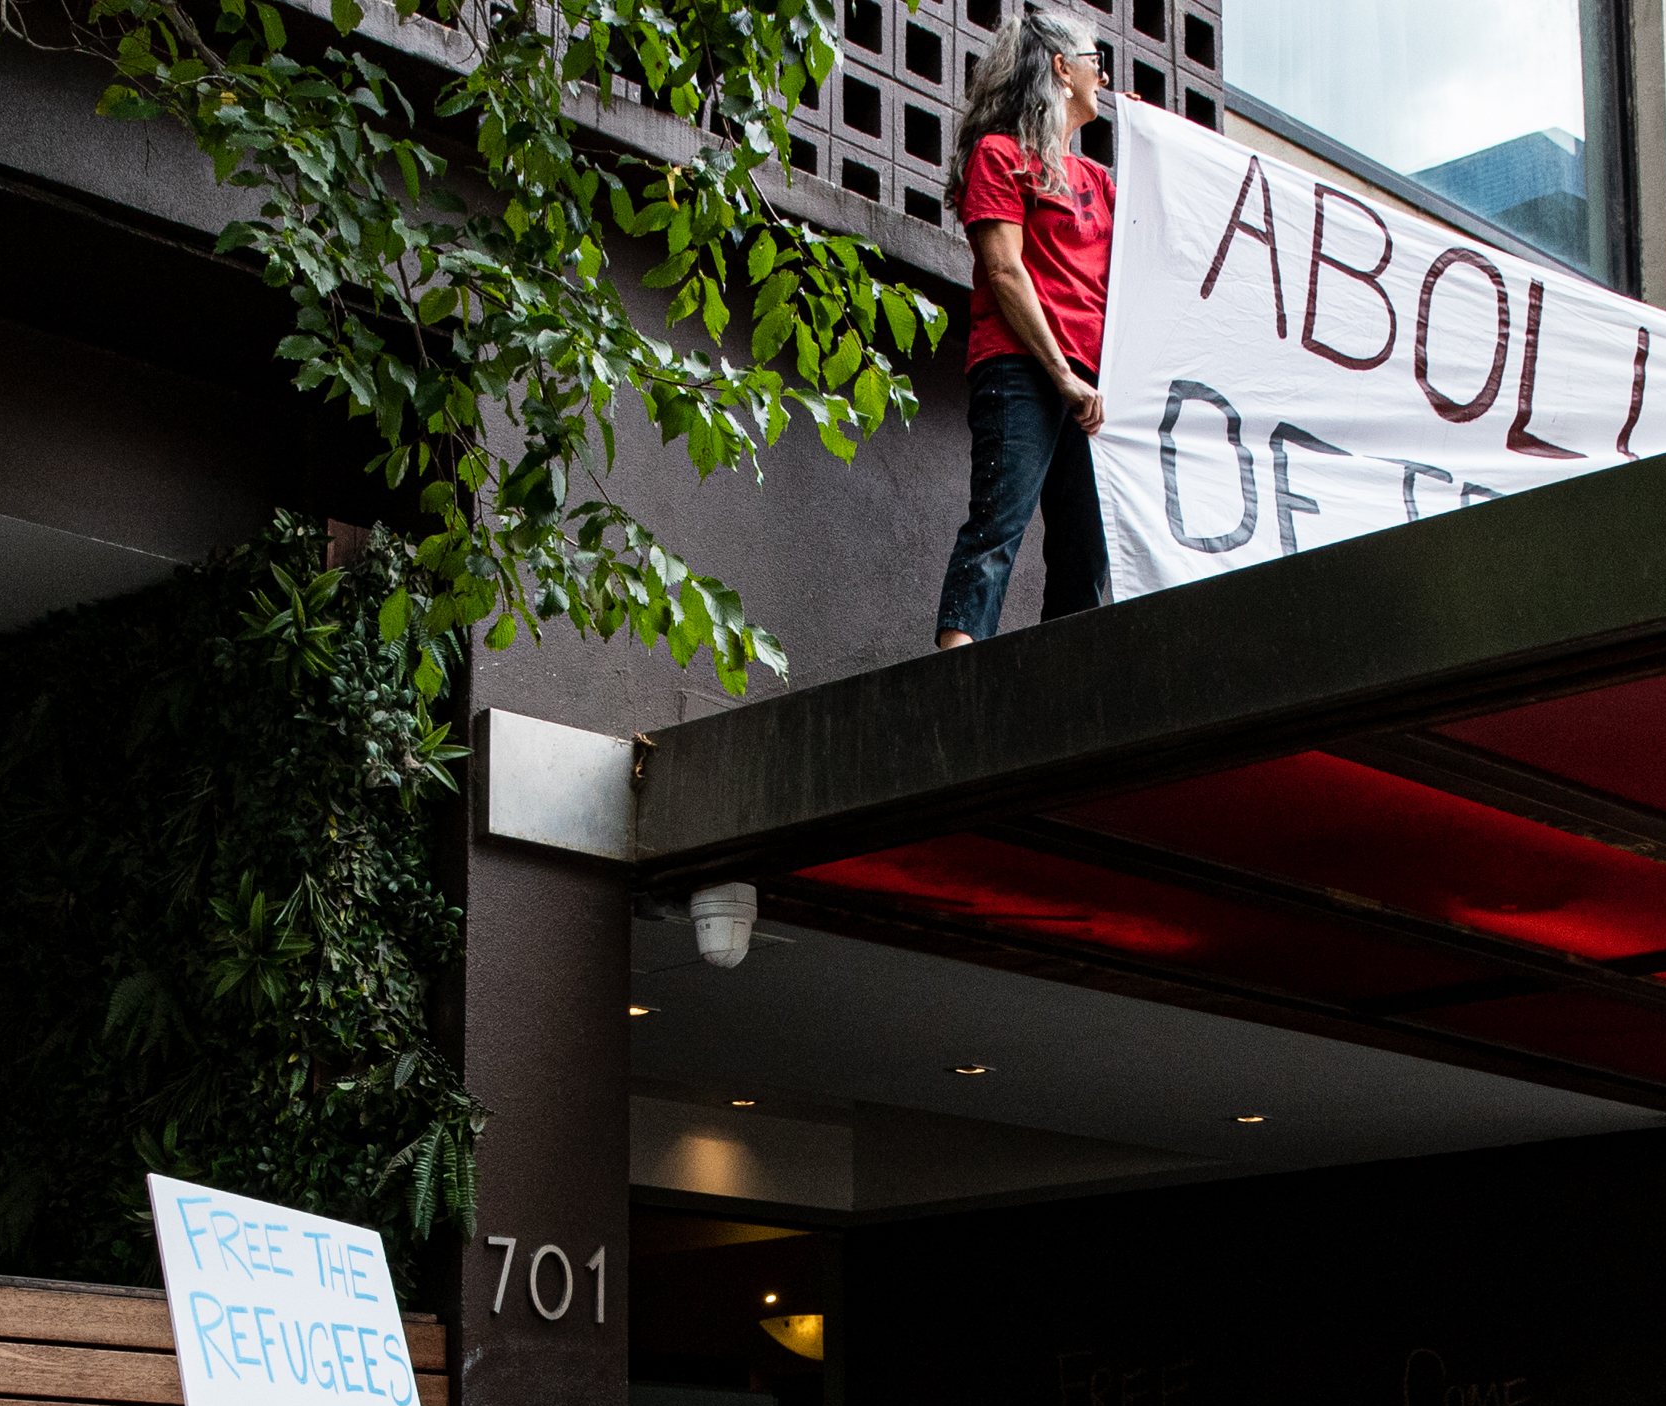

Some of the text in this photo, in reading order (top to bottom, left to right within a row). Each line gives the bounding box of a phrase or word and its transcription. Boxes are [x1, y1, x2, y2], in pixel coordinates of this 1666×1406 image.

[1158, 380, 1350, 556] OF
[177, 1197, 379, 1303] FREE THE
[488, 1236, 605, 1324] 701
[189, 1291, 413, 1406] REFUGEES
